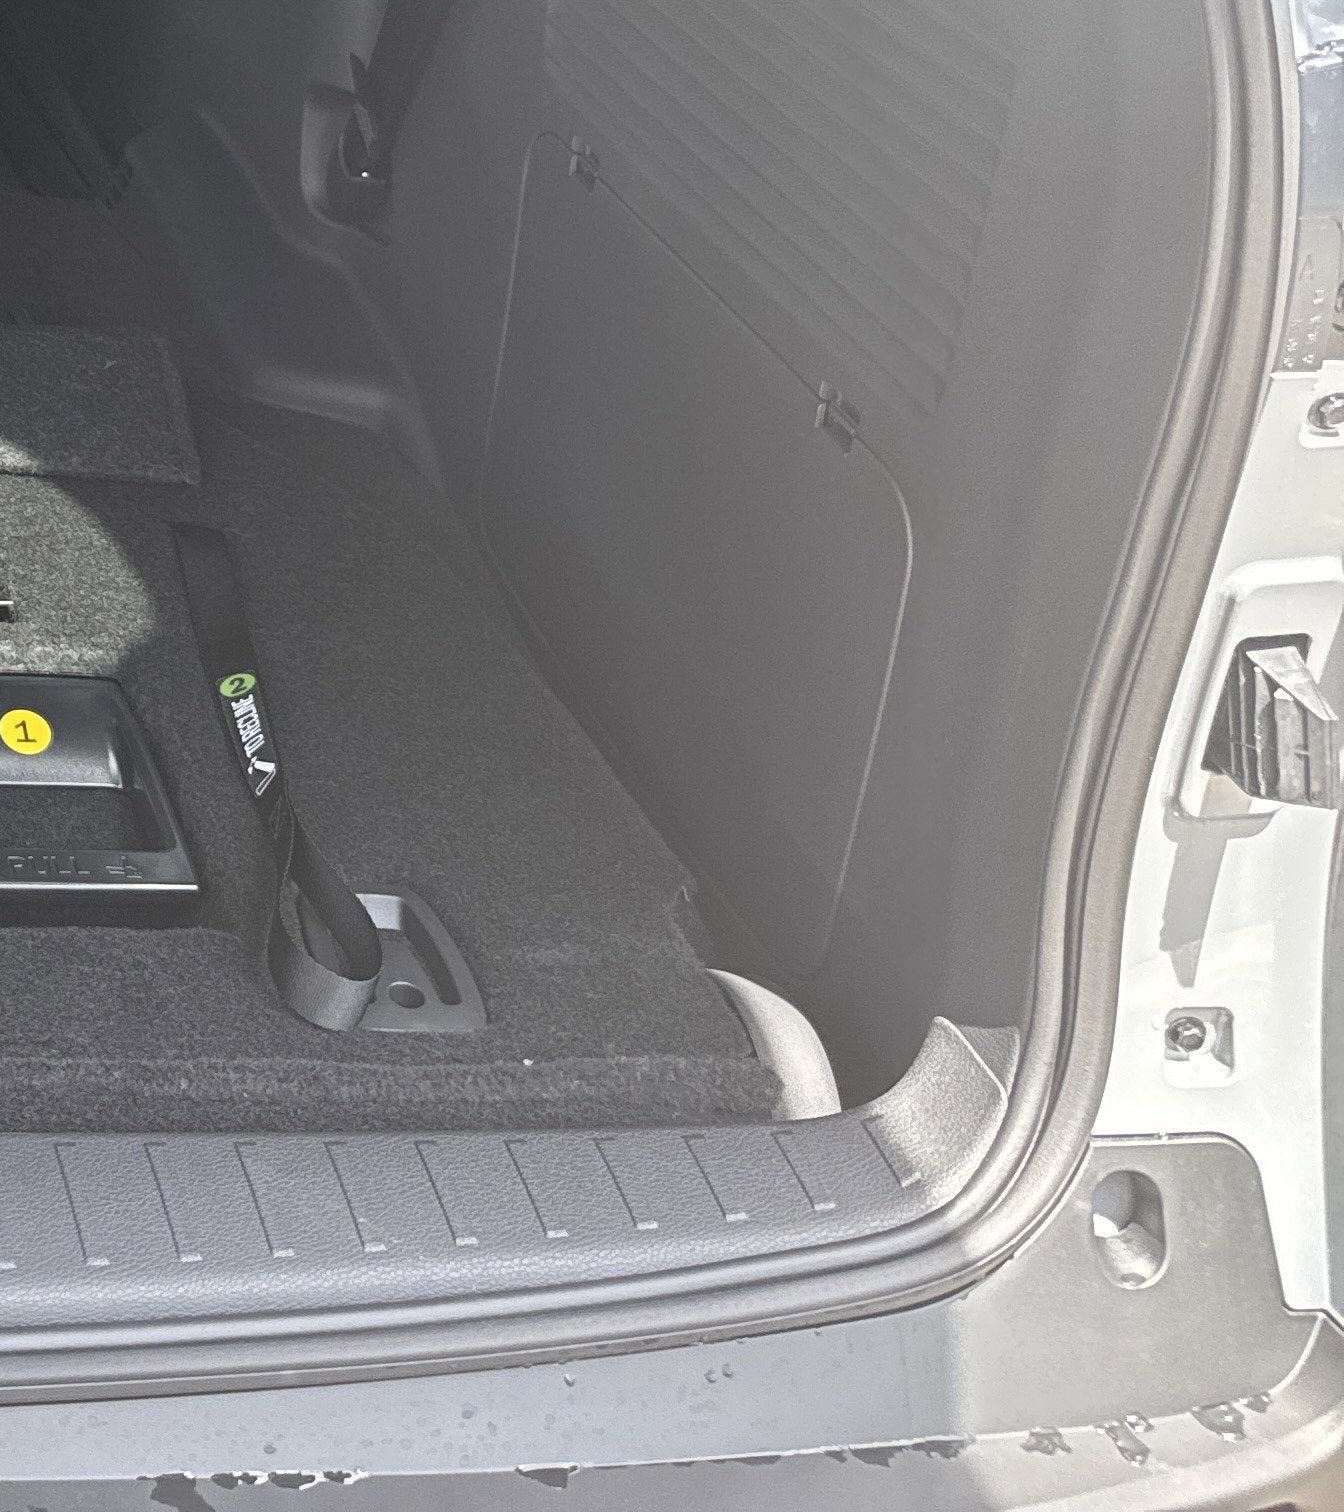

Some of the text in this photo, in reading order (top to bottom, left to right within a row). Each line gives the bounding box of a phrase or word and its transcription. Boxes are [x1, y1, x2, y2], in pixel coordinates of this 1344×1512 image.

[228, 676, 248, 695] 2
[14, 719, 37, 743] 1
[231, 694, 266, 758] TO RECLINE
[7, 855, 91, 875] PULL
